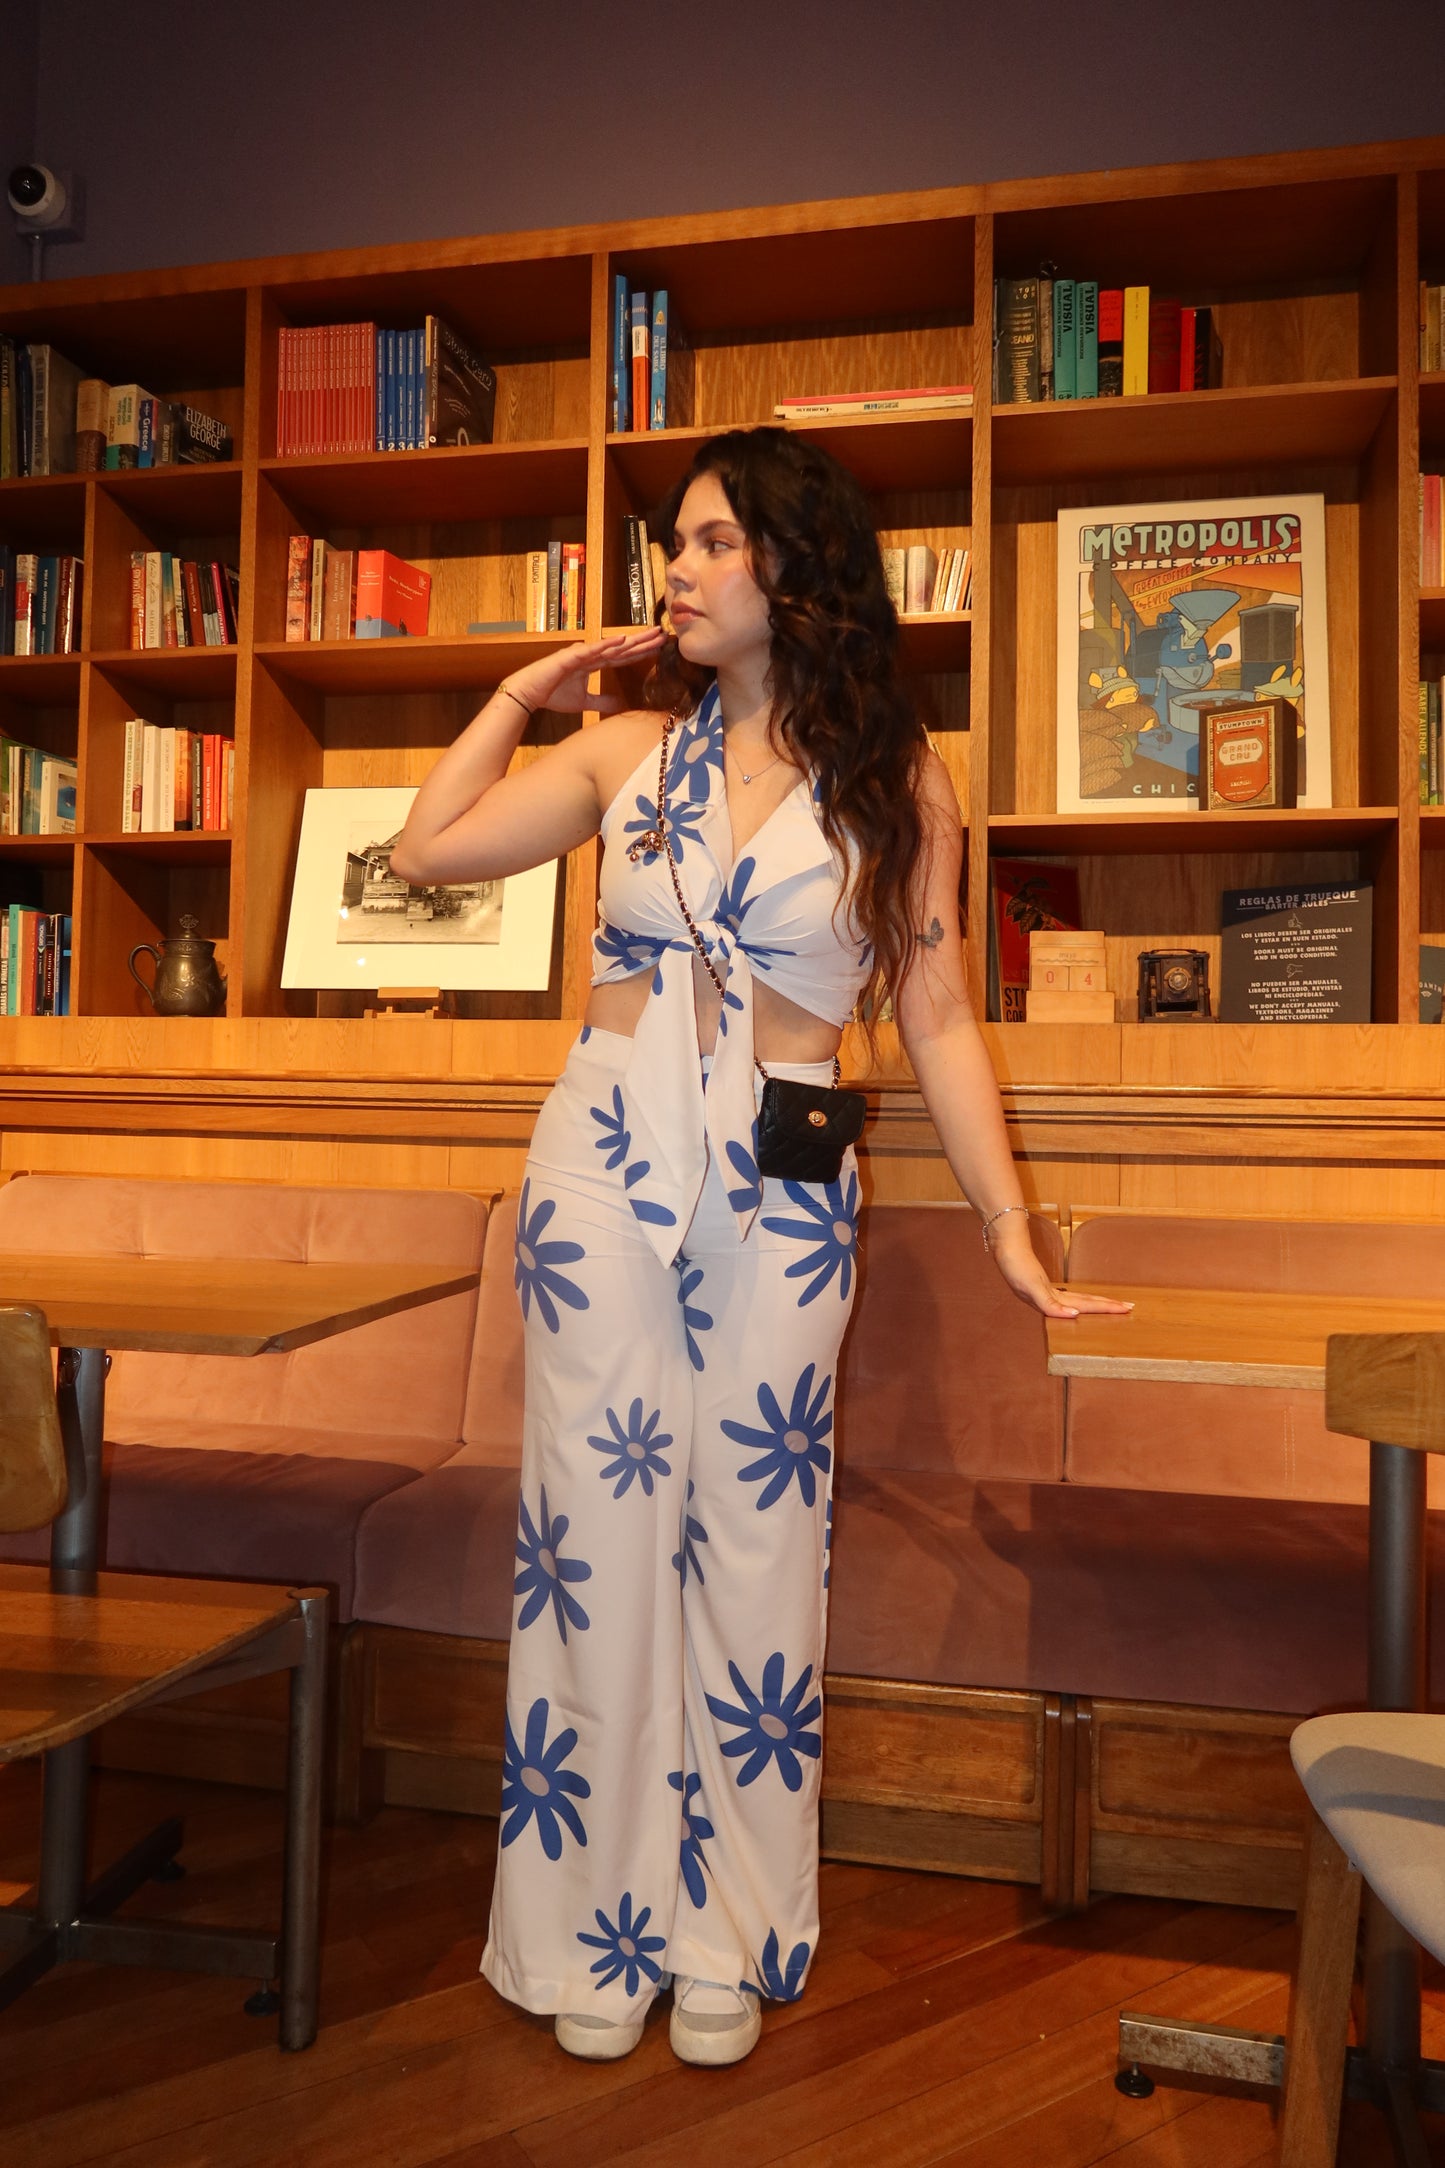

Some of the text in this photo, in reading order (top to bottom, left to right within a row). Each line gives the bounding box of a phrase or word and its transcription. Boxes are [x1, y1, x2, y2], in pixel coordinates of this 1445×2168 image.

[1063, 285, 1073, 333] VISUAL
[1085, 286, 1095, 335] VISUAL
[186, 407, 227, 438] ELIZABETH
[143, 418, 151, 451] Greece
[190, 424, 221, 450] GEORGE
[377, 441, 384, 450] 1
[388, 442, 395, 451] 2
[398, 442, 405, 450] 3
[407, 442, 414, 450] 4
[418, 441, 425, 449] 5
[1093, 553, 1292, 571] COFFEE COMPANY
[1161, 565, 1191, 584] COFFEE
[1219, 719, 1262, 730] STUMPTOWN
[1419, 687, 1427, 756] ISABEL ALLENDE
[1222, 743, 1258, 754] GRAND
[1229, 752, 1250, 761] CRU
[1132, 783, 1195, 794] CHIC
[1240, 890, 1356, 906] REGLAS DE TRUEQUE
[1265, 900, 1329, 910] BARTER RULES
[0, 960, 8, 984] PRIMERA
[1046, 971, 1093, 985] 0 4
